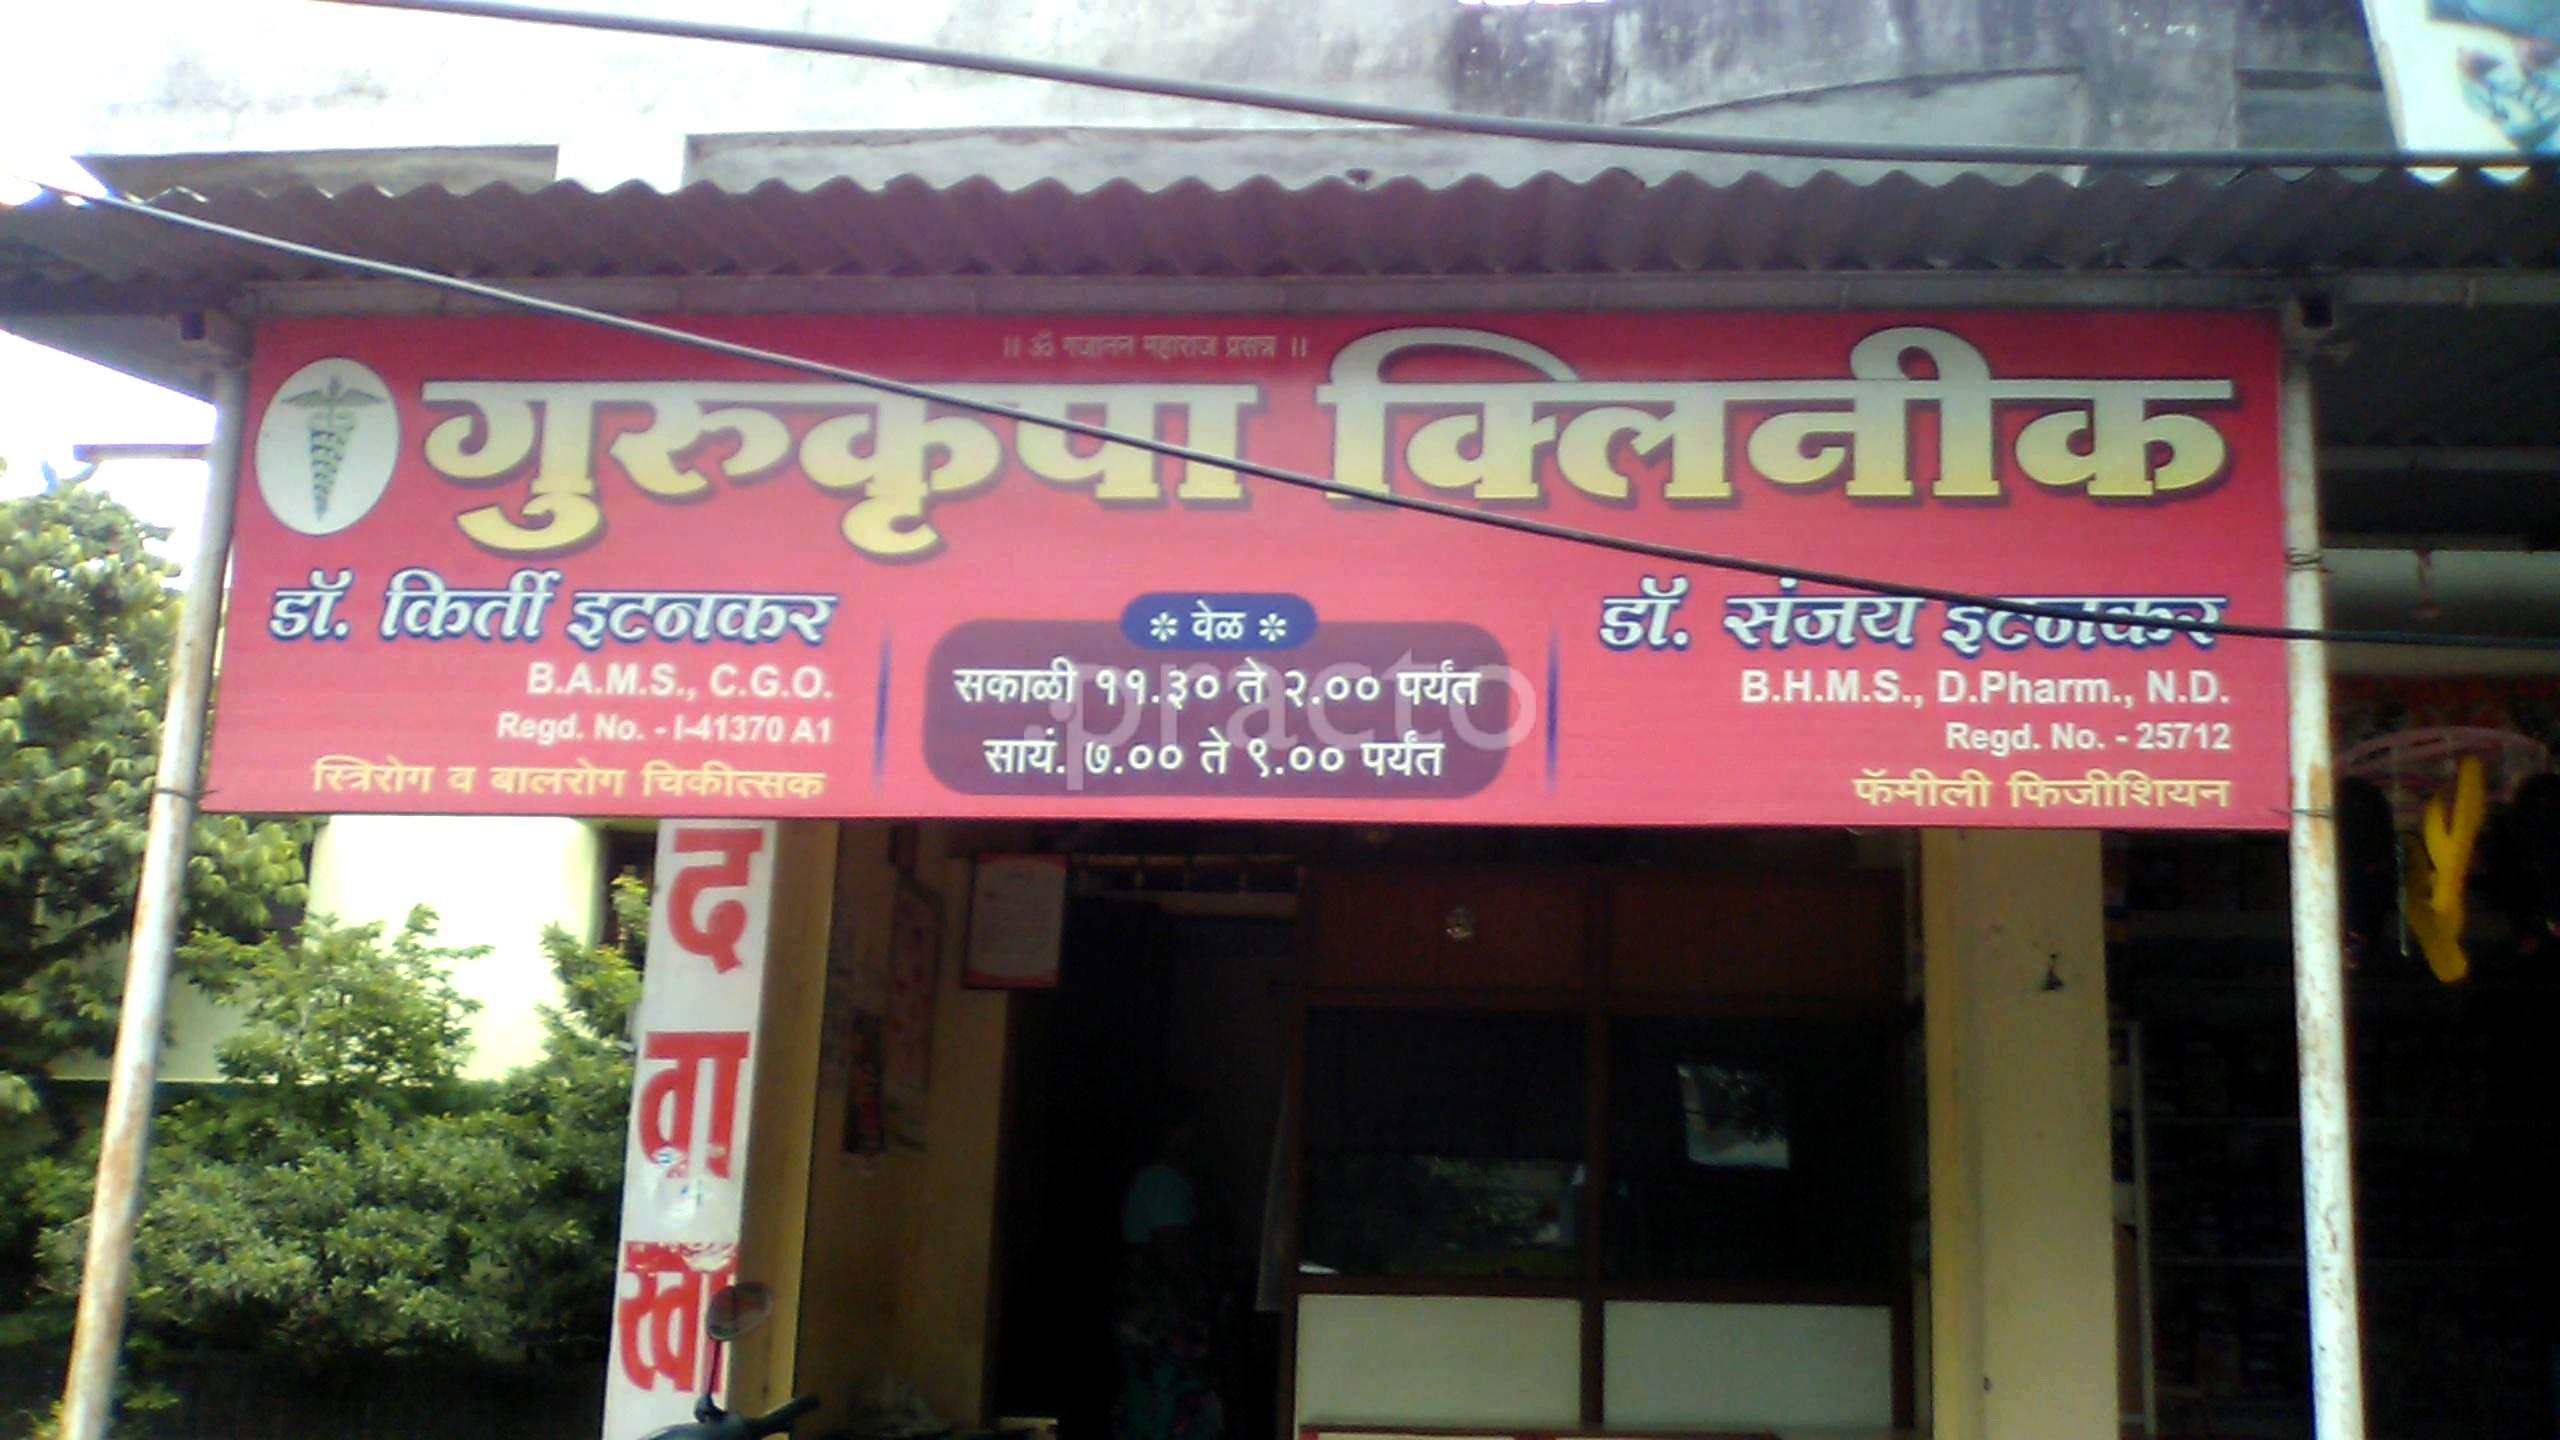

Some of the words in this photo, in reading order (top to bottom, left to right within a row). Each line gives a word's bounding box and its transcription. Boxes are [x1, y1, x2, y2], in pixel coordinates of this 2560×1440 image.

[1062, 335, 1134, 358] गजानन
[1142, 335, 1218, 360] महाराज
[1225, 335, 1276, 359] प्रसन्न
[421, 381, 1261, 556] गुरुकृपा
[1316, 326, 2233, 499] क्लिनीक
[270, 568, 352, 641] डॉ.
[379, 567, 562, 641] किर्ती
[567, 590, 838, 651] इटनकर
[1190, 600, 1247, 641] वेळ
[1599, 576, 1689, 650] डॉ.
[1724, 577, 1924, 649] संजय
[1943, 595, 2226, 658] इटनकर
[527, 664, 697, 703] B.A.M.S.,
[709, 664, 834, 700] C.G.O.
[953, 656, 1077, 706] सकाळी
[1095, 668, 1219, 710] ११.३०
[1236, 657, 1267, 706] ते
[1284, 668, 1381, 707] २.००
[1396, 660, 1481, 707] पर्यंत
[1741, 671, 1923, 708] B.H.M.S.,
[1937, 671, 2134, 708] D.Pharm.,
[2147, 671, 2231, 704] N.D.
[497, 712, 584, 746] Regd.
[594, 713, 644, 741] No.
[793, 714, 833, 744] A1
[1946, 724, 2041, 757] Regd.
[2051, 724, 2106, 750] No.
[2136, 725, 2231, 750] 25712
[983, 727, 1067, 775] सायं.
[1084, 744, 1183, 775] ७.००
[1199, 726, 1231, 775] ते
[1247, 738, 1345, 776] ९.००
[1361, 733, 1446, 777] पर्यंत
[447, 765, 474, 793] व
[489, 756, 627, 797] बालरोग
[641, 756, 826, 800] चिकीत्सक
[1853, 767, 1990, 809] फॅमीली
[2009, 767, 2231, 809] फिजीशियन
